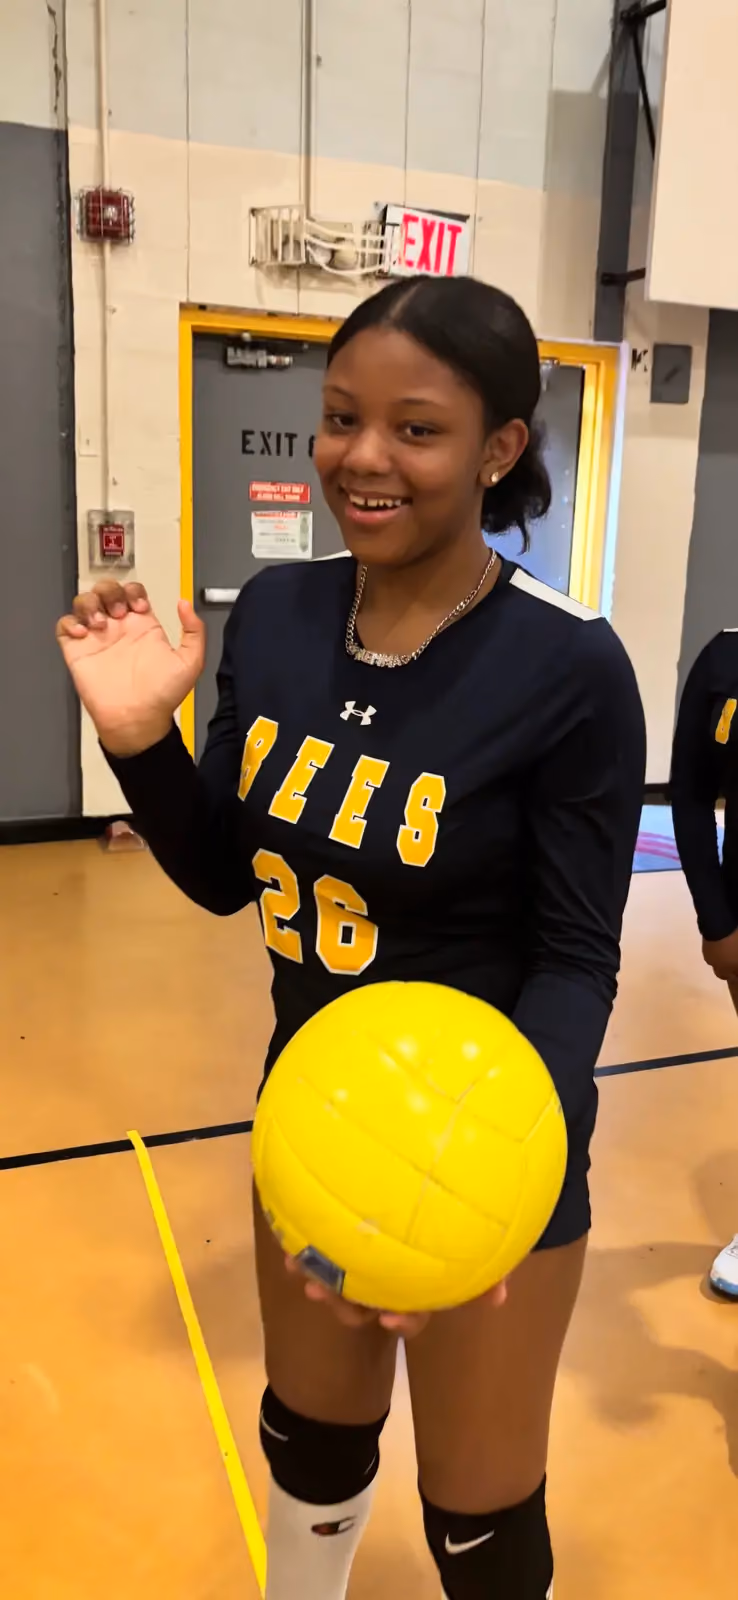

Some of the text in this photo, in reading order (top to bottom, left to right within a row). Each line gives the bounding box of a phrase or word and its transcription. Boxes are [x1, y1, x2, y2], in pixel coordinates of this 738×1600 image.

[400, 212, 462, 278] EXIT
[242, 429, 298, 457] EXIT
[238, 715, 446, 867] BEES
[252, 848, 379, 976] 26
